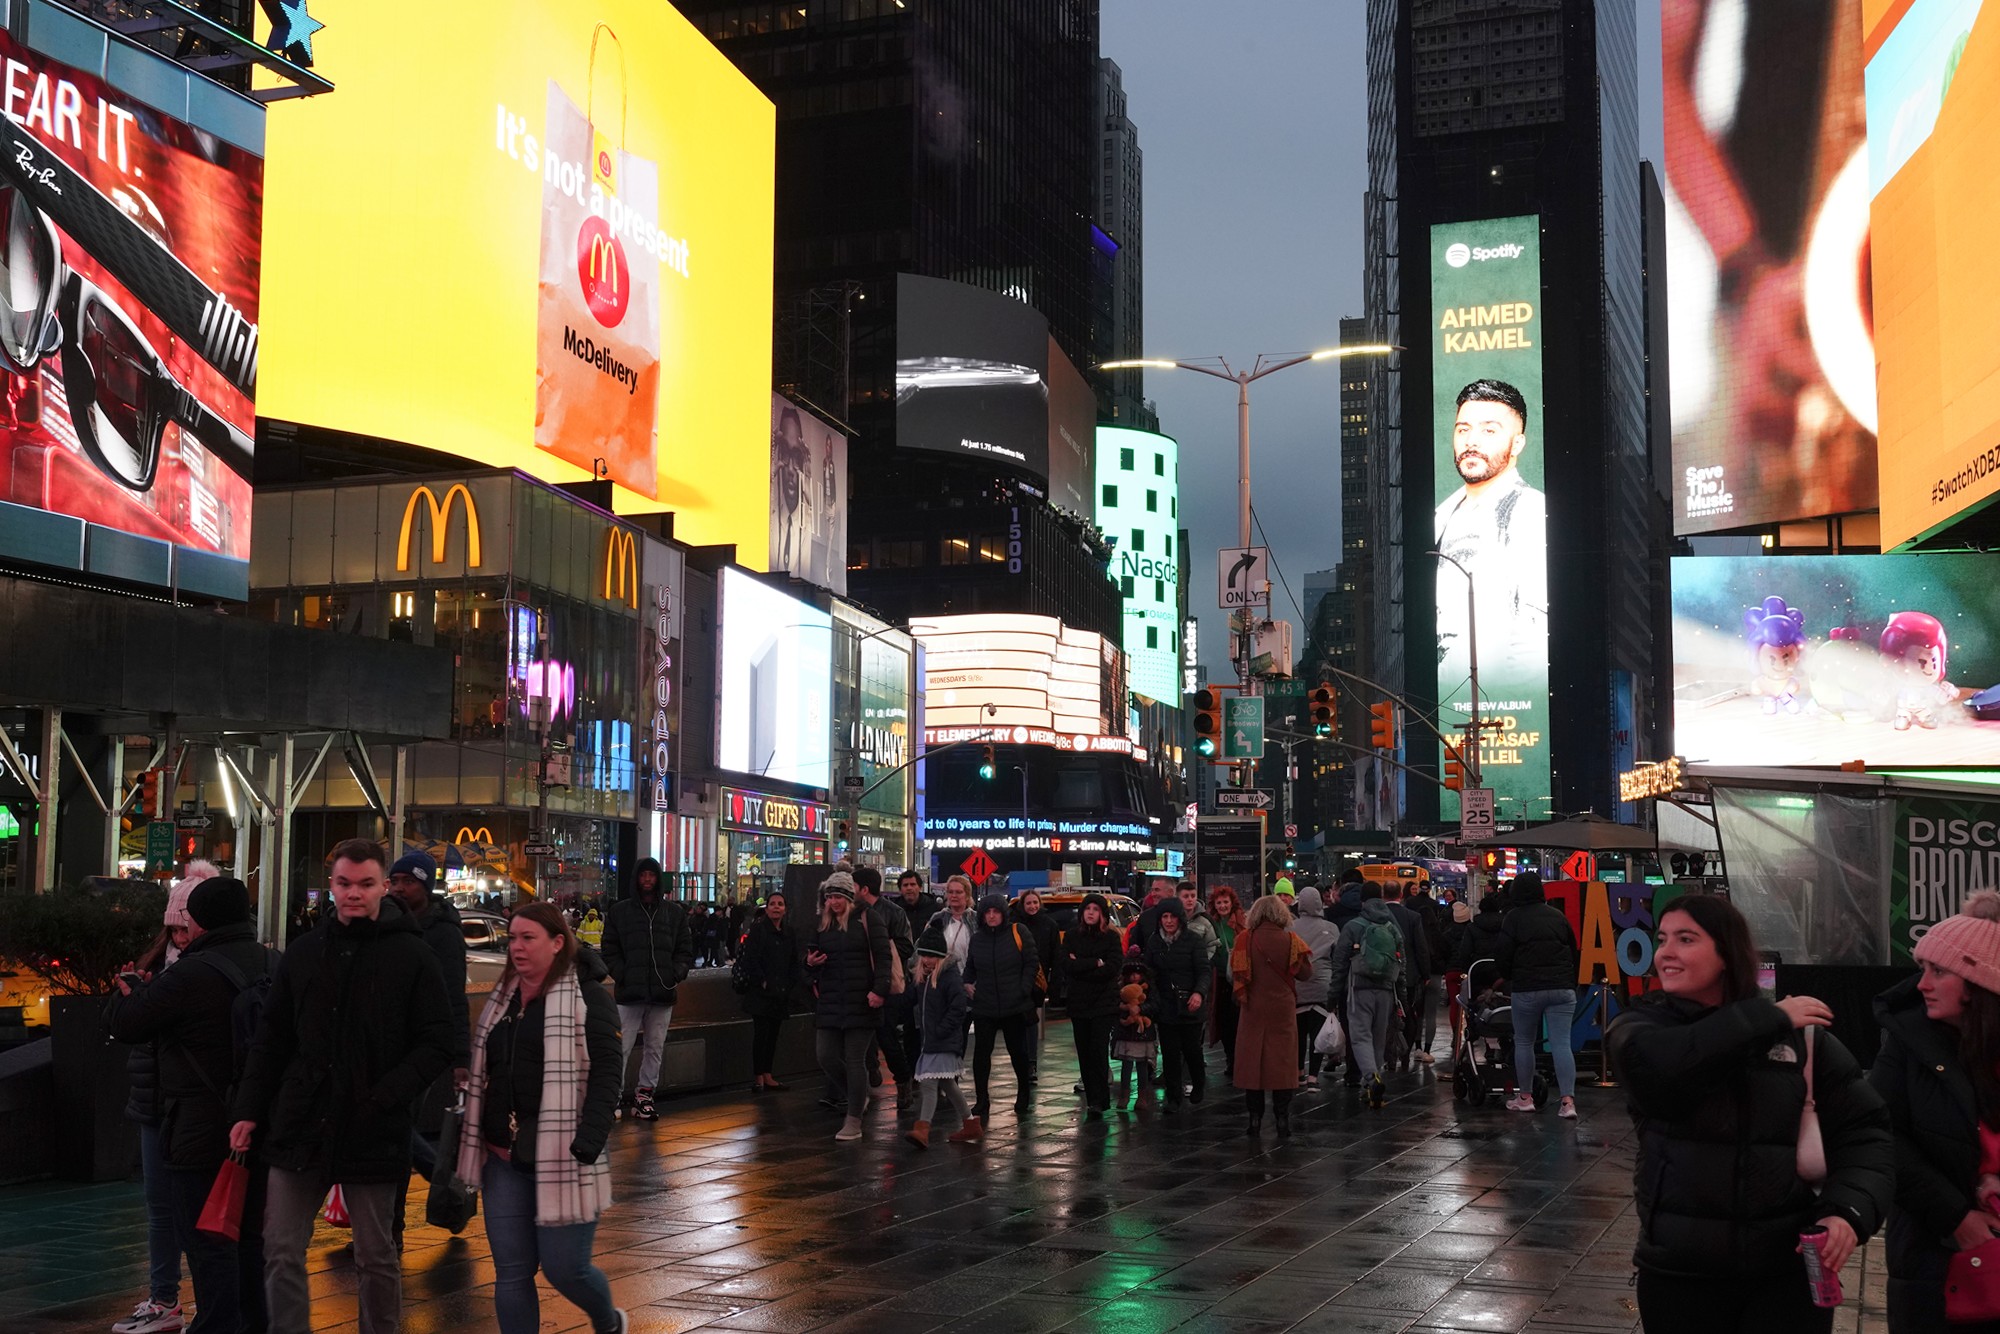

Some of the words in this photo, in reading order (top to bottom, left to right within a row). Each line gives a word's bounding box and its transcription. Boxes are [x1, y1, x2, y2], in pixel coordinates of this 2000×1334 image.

[3, 57, 82, 150] EAR
[97, 96, 143, 178] IT.
[13, 140, 63, 196] Ray-Ban
[496, 103, 539, 173] It's
[544, 147, 586, 207] not
[590, 182, 605, 220] a
[609, 194, 690, 279] present
[1472, 243, 1522, 262] Spotify
[1440, 302, 1533, 330] AHMED
[1444, 328, 1532, 354] KAMEL
[563, 324, 639, 395] McDelivery
[961, 438, 969, 447] At
[980, 442, 992, 451] 1.75
[1686, 465, 1724, 482] Save
[1932, 444, 2000, 506] #SwatchXDBZ
[1686, 480, 1718, 496] The
[1687, 493, 1733, 511] Music
[1687, 506, 1733, 518] FOUNDATION
[1008, 507, 1021, 574] 1500
[1226, 591, 1259, 604] ONLY
[929, 674, 967, 684] WEDNESDAYS
[1266, 685, 1275, 694] W
[1280, 683, 1293, 695] 45
[1453, 702, 1472, 711] THE
[1498, 701, 1532, 711] ALBUM
[1227, 720, 1260, 728] Broadway
[937, 728, 1011, 744] ELEMENTARY
[875, 728, 904, 768] NAVY
[1091, 737, 1125, 752] ABBOTT
[1489, 749, 1523, 764] LEIL
[1223, 794, 1240, 803] ONE
[1247, 794, 1265, 803] WAY
[727, 793, 733, 821] I
[765, 800, 799, 830] GIFTS
[802, 805, 807, 830] I
[1466, 810, 1490, 824] 25
[935, 819, 945, 829] to
[947, 818, 958, 829] 60
[959, 820, 991, 831] years
[993, 819, 1006, 829] to
[1008, 818, 1025, 829] life
[1027, 818, 1036, 829] in
[1059, 822, 1097, 833] Murder
[1100, 822, 1129, 835] charges
[1908, 816, 2000, 847] DISC
[861, 836, 871, 850] OLD
[872, 837, 885, 852] NAVY
[936, 837, 957, 848] sets
[958, 838, 984, 848] new
[985, 836, 1015, 850] goal:
[1068, 840, 1105, 851] 2-time
[152, 848, 169, 857] South
